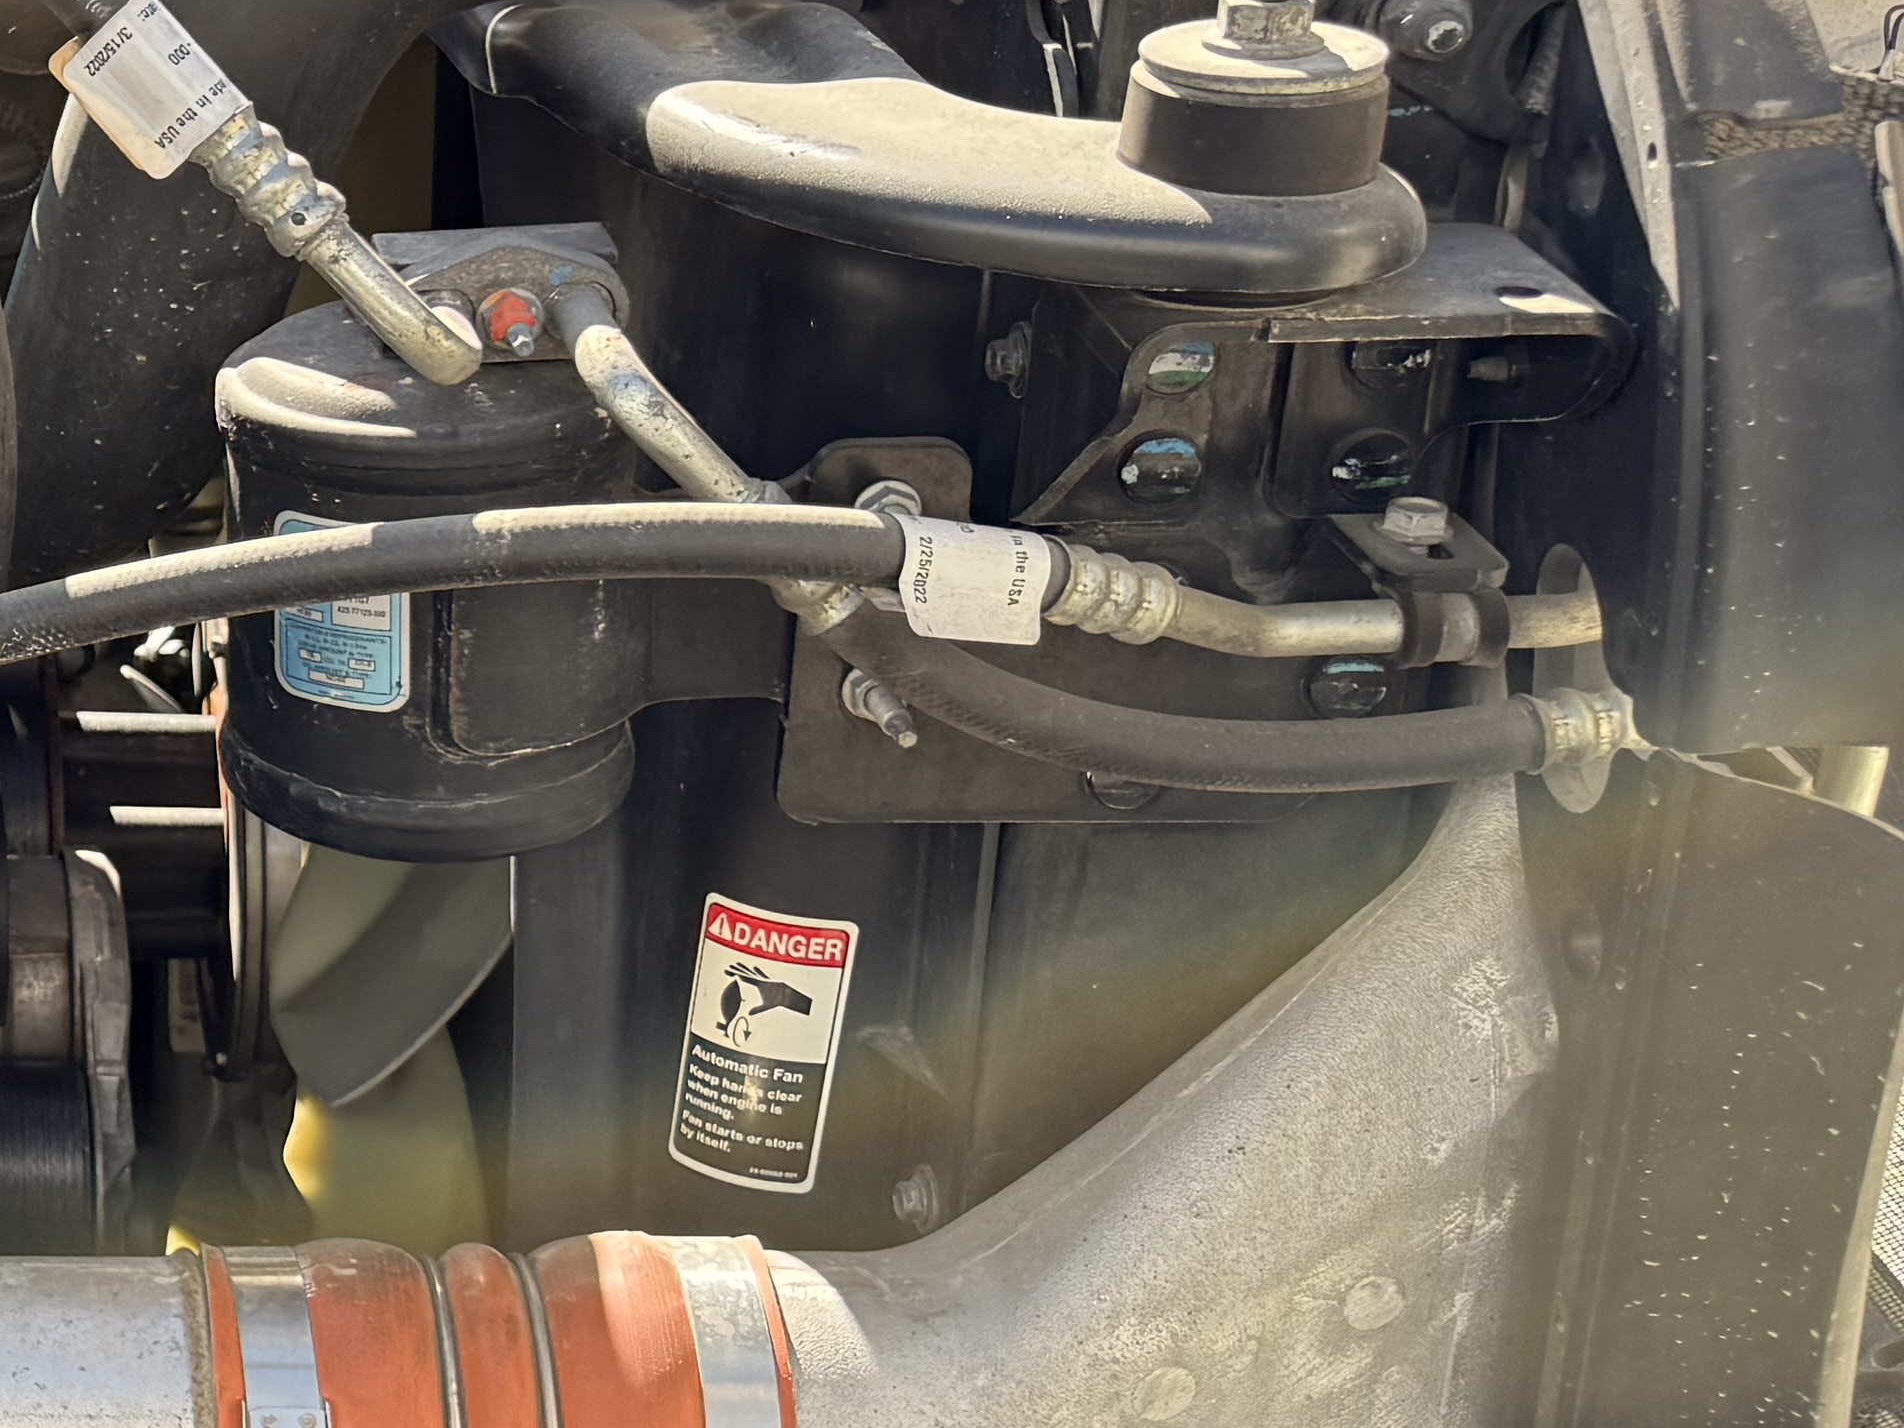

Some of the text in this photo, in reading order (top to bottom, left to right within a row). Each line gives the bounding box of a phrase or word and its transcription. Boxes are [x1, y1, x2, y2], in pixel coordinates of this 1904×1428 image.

[82, 25, 134, 77] 3/15/2022
[175, 106, 199, 128] the
[153, 126, 181, 150] USA
[912, 535, 934, 605] 2/25/2022
[1014, 550, 1030, 574] the
[1007, 577, 1026, 607] USA
[733, 923, 844, 963] DANGER
[690, 1043, 804, 1085] Automatic Fan
[686, 1077, 783, 1115] when engine is
[688, 1063, 803, 1104] Keep hans clear
[684, 1093, 736, 1121] running.
[679, 1123, 731, 1153] by itself.
[680, 1109, 804, 1152] Fan starts or stops
